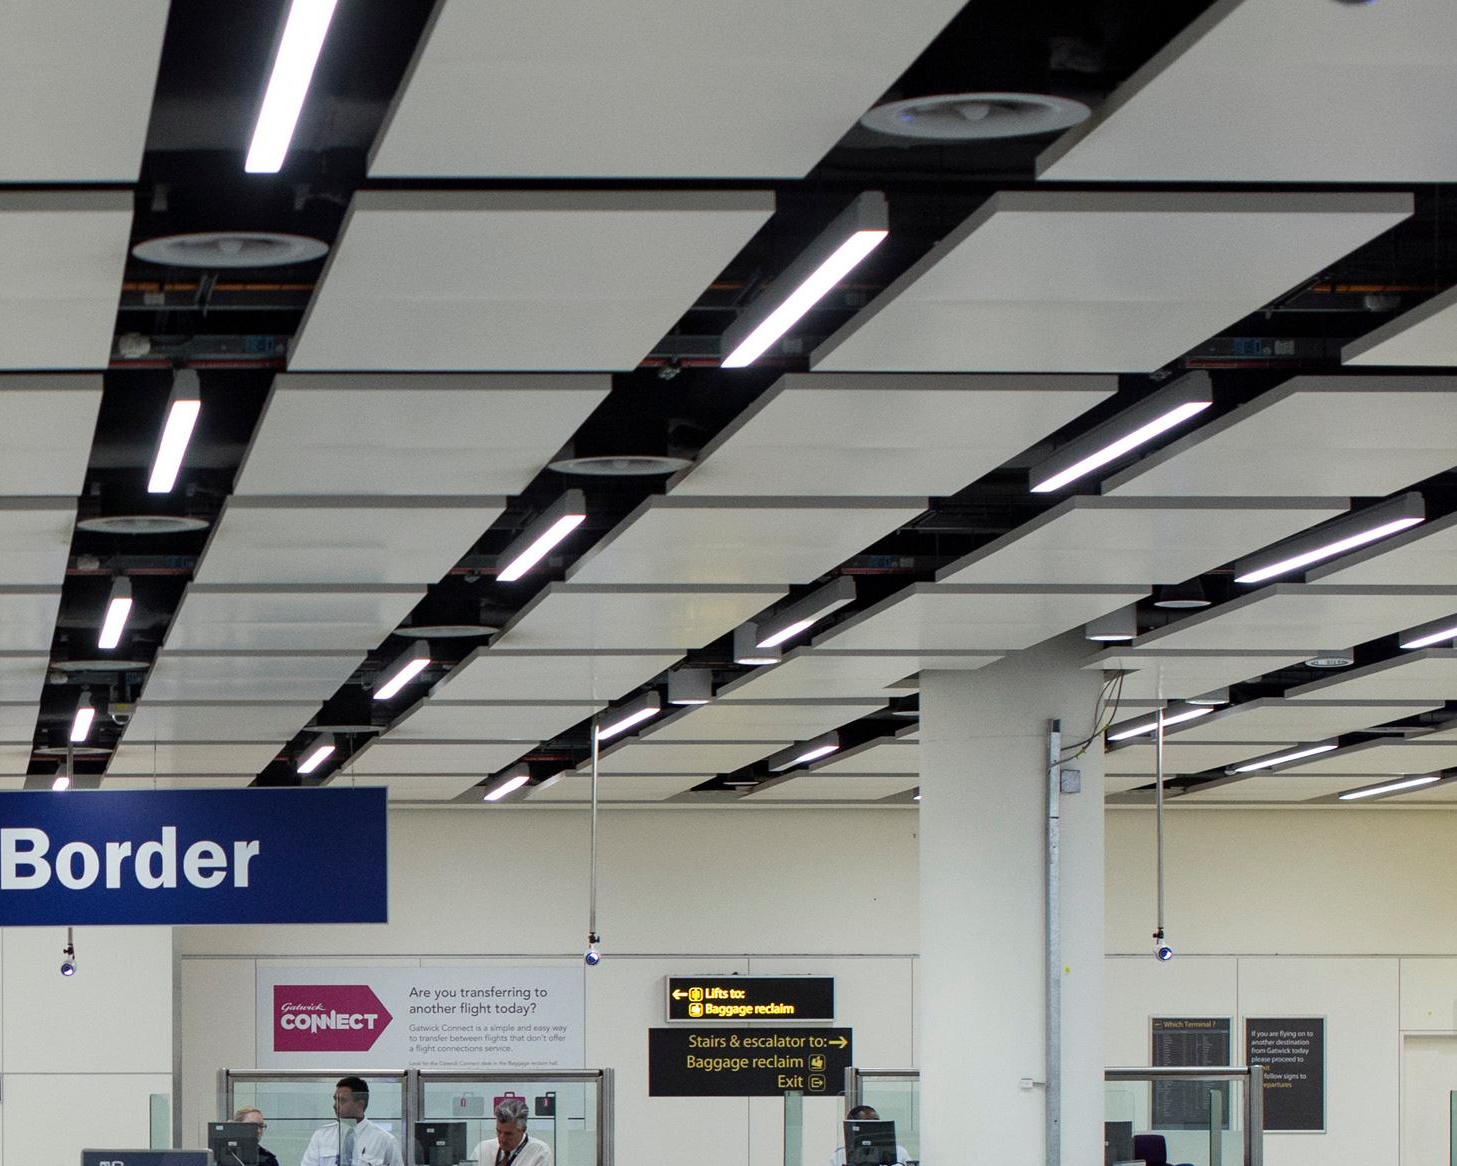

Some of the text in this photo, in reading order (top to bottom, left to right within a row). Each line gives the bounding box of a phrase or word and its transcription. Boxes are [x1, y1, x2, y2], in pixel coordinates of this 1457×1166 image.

[1, 826, 259, 890] Border
[409, 986, 547, 1000] Are you transferring to
[705, 987, 745, 999] Lifts to:
[281, 1002, 326, 1013] Gatwick
[409, 1003, 537, 1016] another flight today?
[705, 1003, 794, 1016] Baggage reclaim
[281, 1009, 378, 1033] CONNECT
[409, 1024, 439, 1032] Gatwick
[441, 1024, 474, 1032] Connect
[475, 1024, 482, 1032] is
[491, 1024, 515, 1034] simple
[516, 1024, 532, 1032] and
[533, 1026, 550, 1034] easy
[552, 1026, 567, 1034] way
[419, 1034, 448, 1042] transfer
[449, 1034, 483, 1042] between
[484, 1034, 508, 1044] flights
[509, 1034, 525, 1042] that
[548, 1034, 566, 1042] offer
[689, 1035, 827, 1048] Stairs & escalator to:
[415, 1044, 436, 1054] flight
[437, 1044, 483, 1052] connections
[687, 1055, 804, 1071] Baggage reclaim
[778, 1075, 804, 1088] Exit
